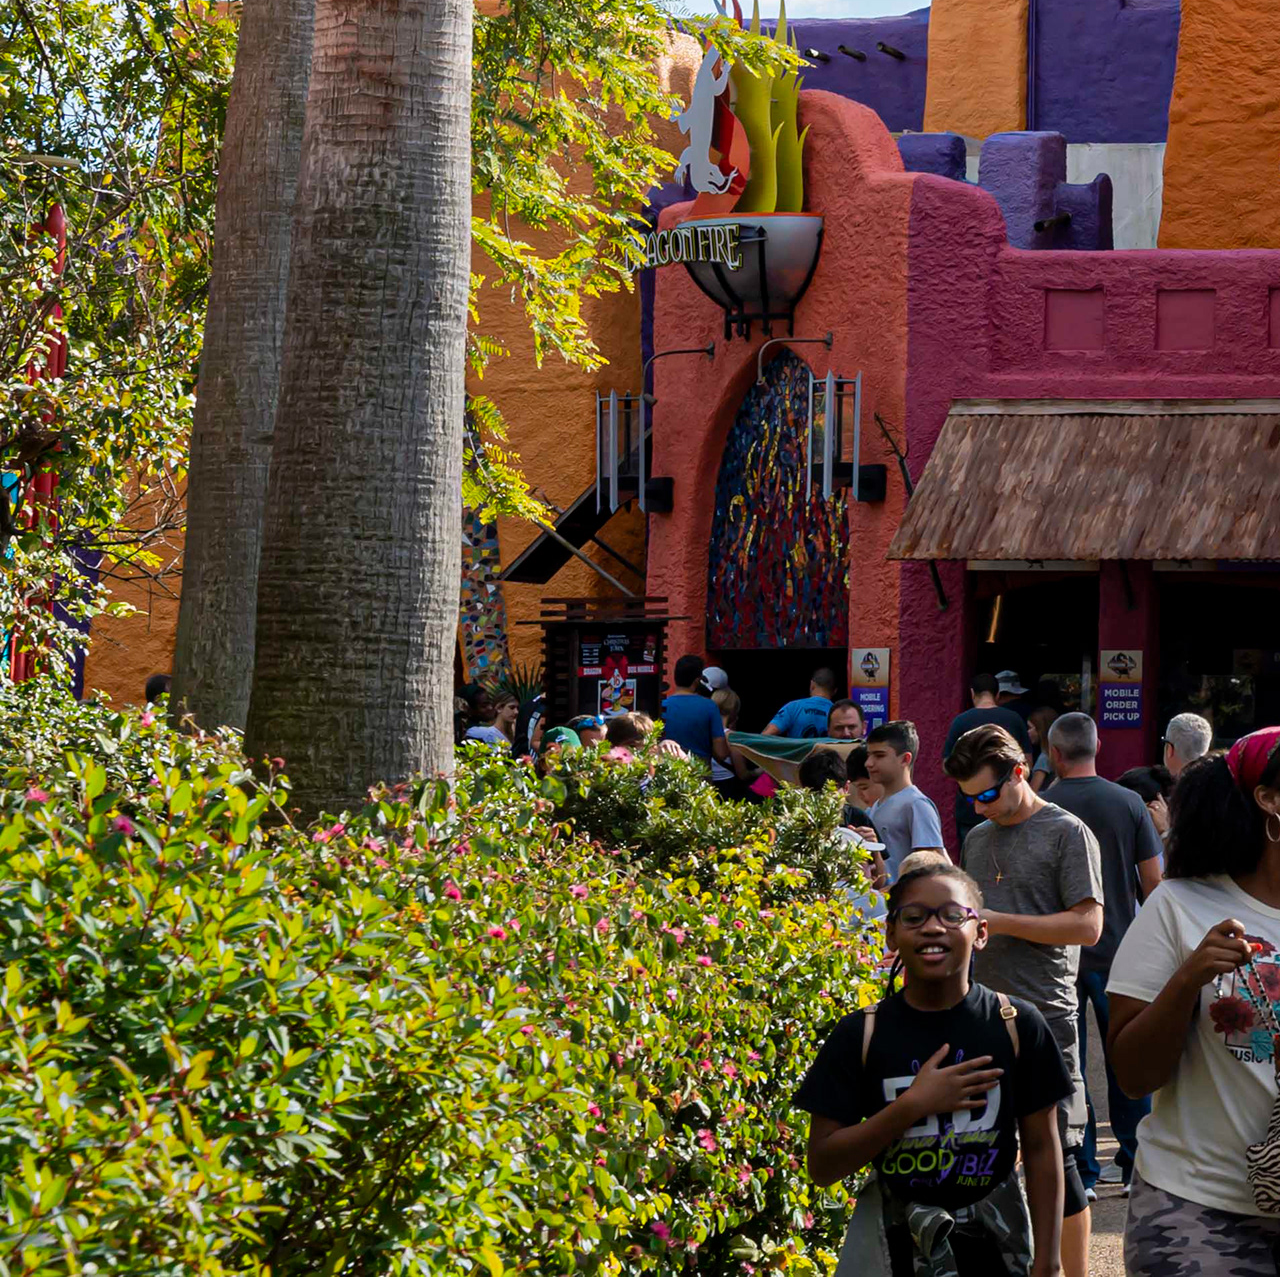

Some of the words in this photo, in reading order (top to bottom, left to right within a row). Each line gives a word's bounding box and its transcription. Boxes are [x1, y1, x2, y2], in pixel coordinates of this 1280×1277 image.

[697, 224, 742, 271] FIRE
[1104, 689, 1139, 697] MOBILE
[1106, 701, 1138, 709] ORDER
[1103, 713, 1124, 721] PICK
[1126, 713, 1140, 721] UP
[882, 1148, 954, 1174] GOOD
